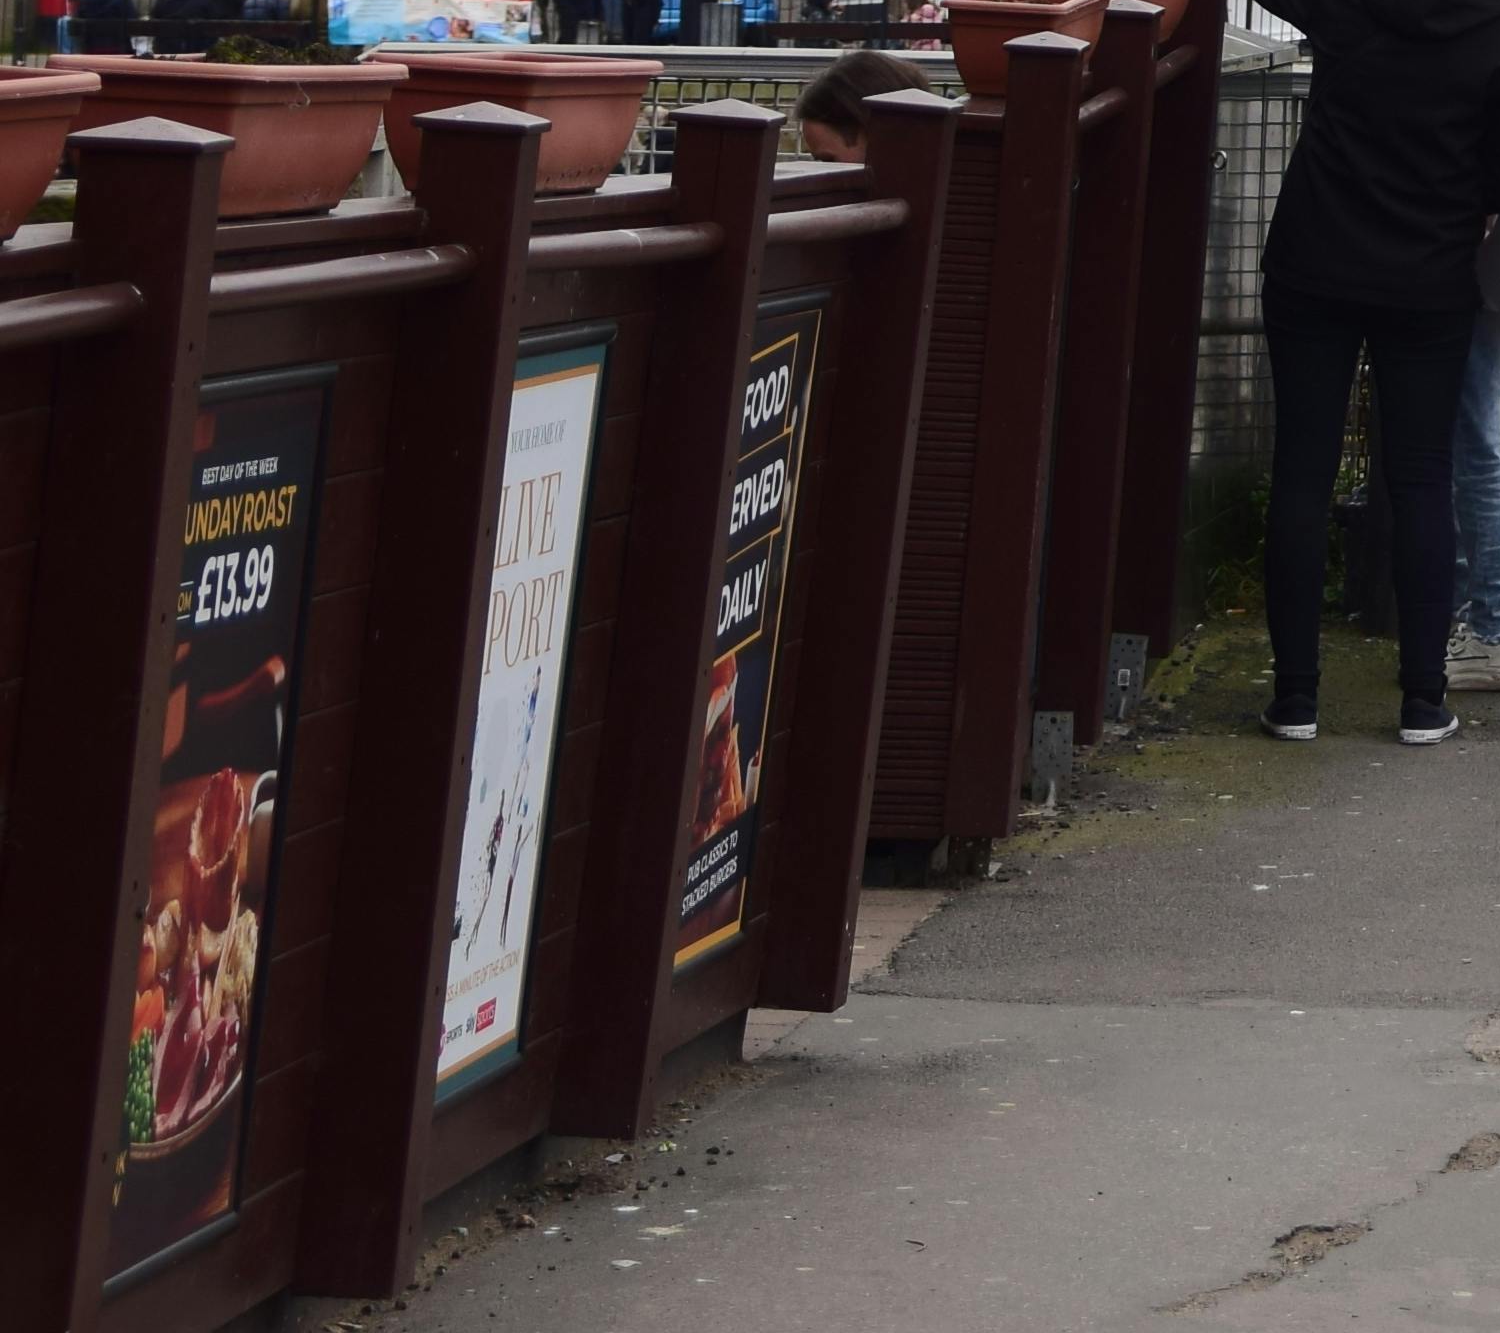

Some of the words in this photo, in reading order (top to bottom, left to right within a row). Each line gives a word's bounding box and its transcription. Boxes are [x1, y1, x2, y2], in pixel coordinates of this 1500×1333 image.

[741, 364, 790, 436] FOOD
[201, 465, 220, 485] BEST
[219, 462, 235, 483] DAY
[234, 461, 244, 480] OF
[244, 459, 259, 477] THE
[258, 456, 279, 476] WEEK
[729, 458, 785, 536] ERVED
[184, 494, 244, 545] UNDAY
[242, 485, 298, 533] ROAST
[494, 471, 562, 570] LIVE
[176, 590, 193, 612] OM
[194, 544, 275, 624] £13.99
[716, 559, 767, 637] DAILY
[484, 569, 565, 676] PORT
[681, 878, 710, 916] STACKED
[709, 854, 739, 893] BURGERS
[687, 859, 701, 886] PUB
[701, 836, 730, 873] CLASSICS
[729, 829, 739, 851] TO
